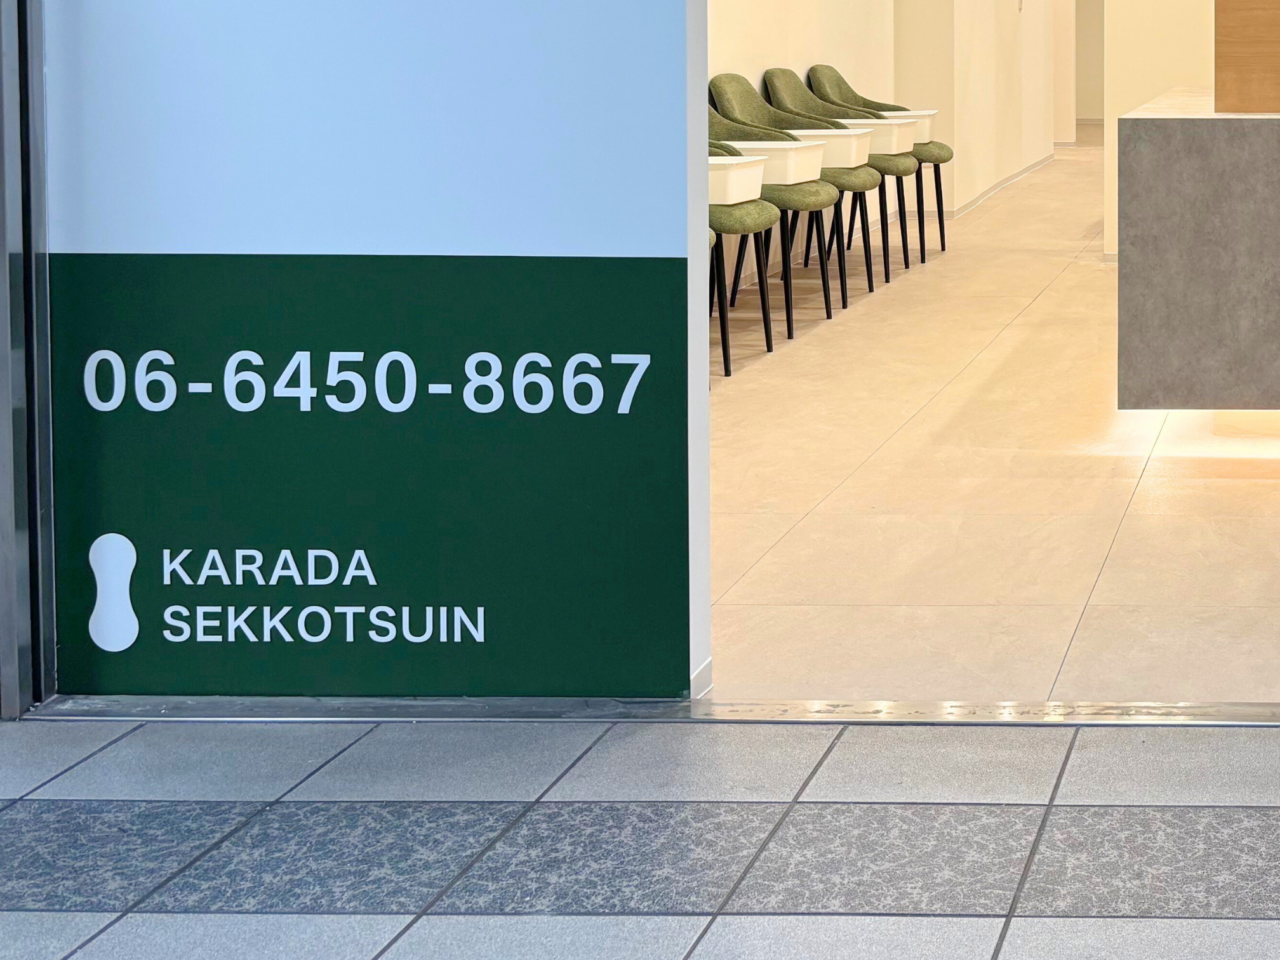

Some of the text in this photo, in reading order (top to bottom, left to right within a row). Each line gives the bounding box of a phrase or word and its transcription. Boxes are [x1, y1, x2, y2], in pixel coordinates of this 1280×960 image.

[83, 349, 651, 415] 06-6450-8667
[162, 549, 378, 586] KARADA
[162, 605, 486, 643] SEKKOTSUIN
